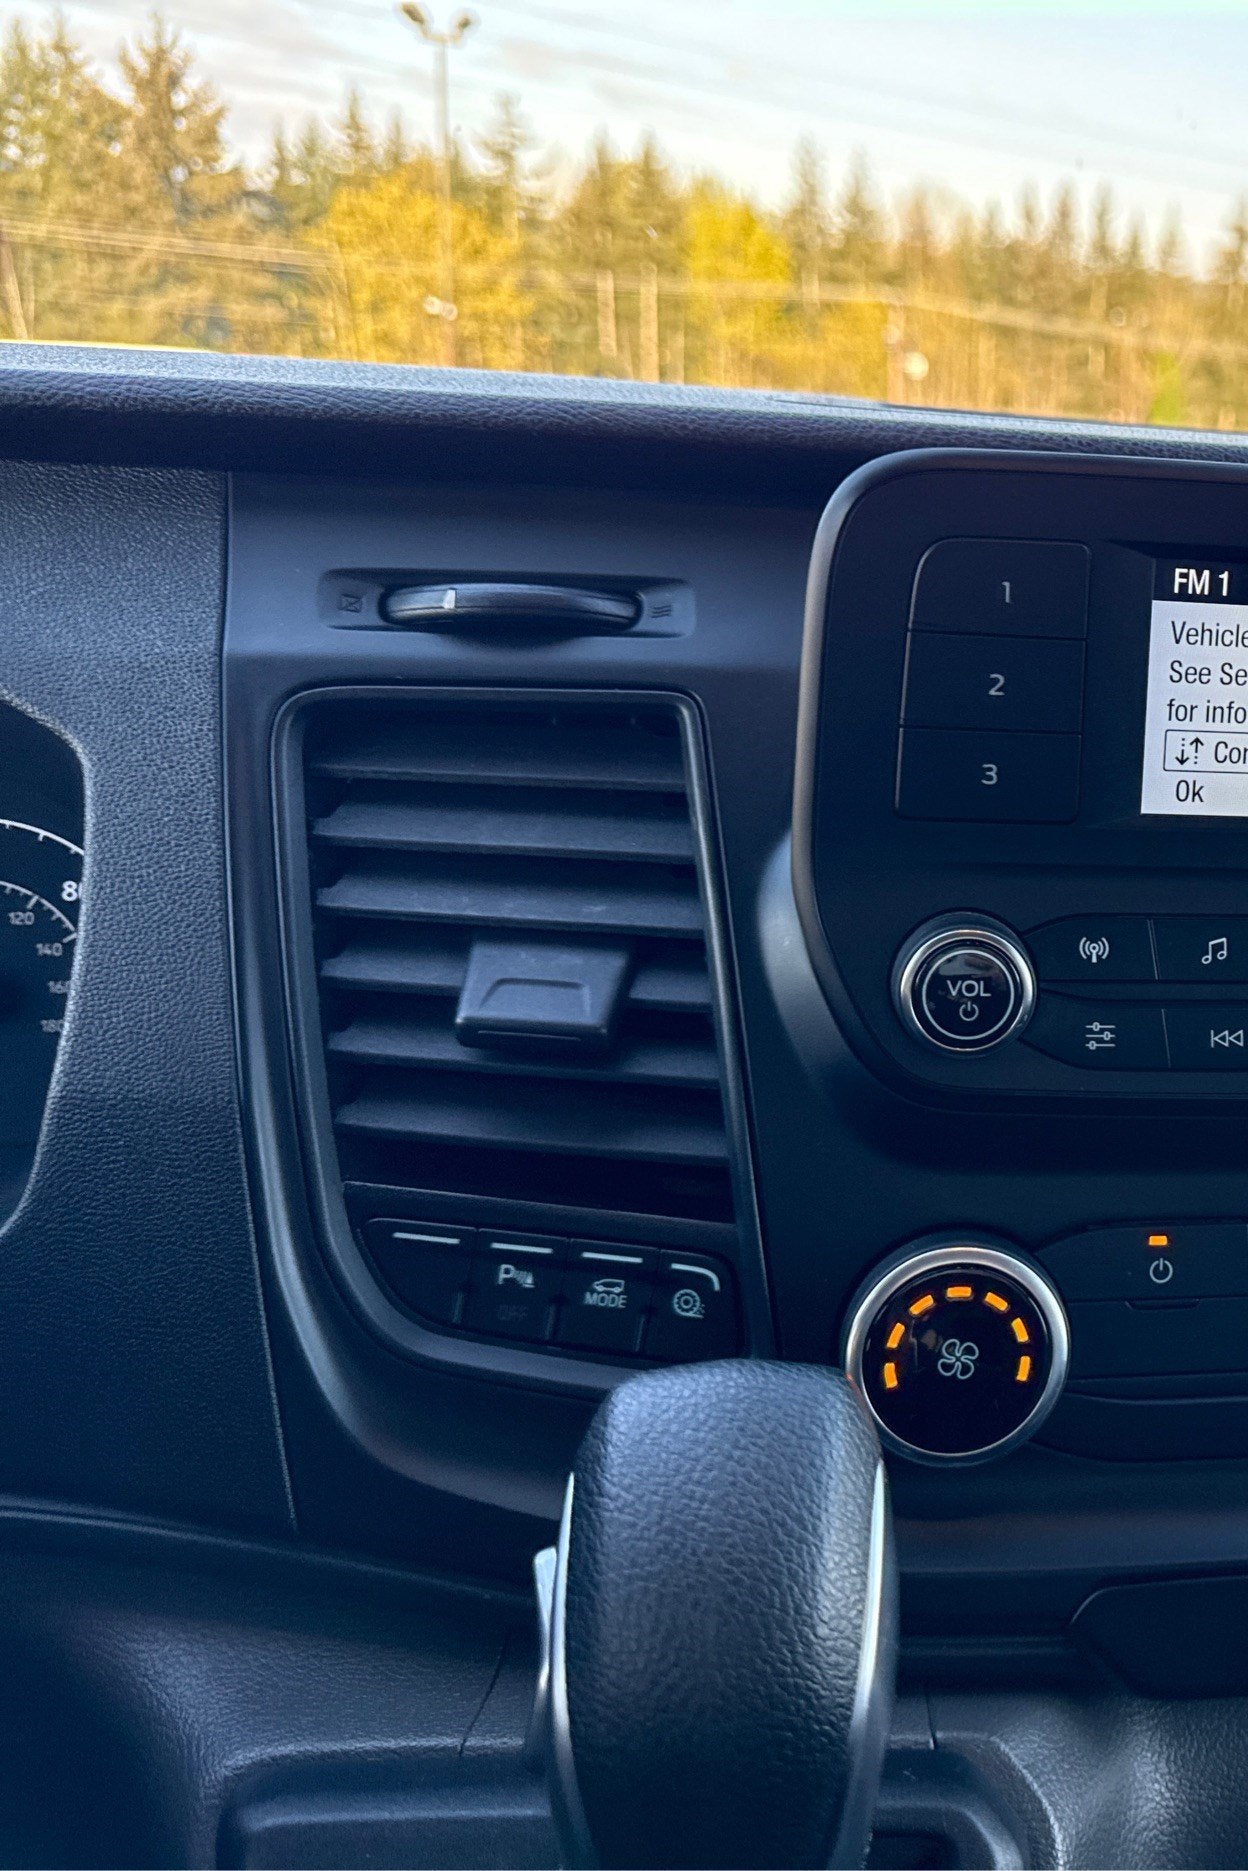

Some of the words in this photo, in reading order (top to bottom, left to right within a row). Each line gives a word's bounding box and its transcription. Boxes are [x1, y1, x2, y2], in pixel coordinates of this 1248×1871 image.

[1001, 581, 1011, 604] 1
[1173, 567, 1210, 596] FM
[1218, 570, 1231, 597] 1
[1169, 659, 1212, 685] See
[988, 673, 1005, 696] 2
[1167, 698, 1199, 723] for
[981, 763, 998, 785] 3
[1175, 779, 1205, 803] Ok
[61, 880, 81, 902] 8
[8, 911, 35, 926] 120
[946, 979, 992, 998] VOL
[583, 1291, 628, 1309] MODE
